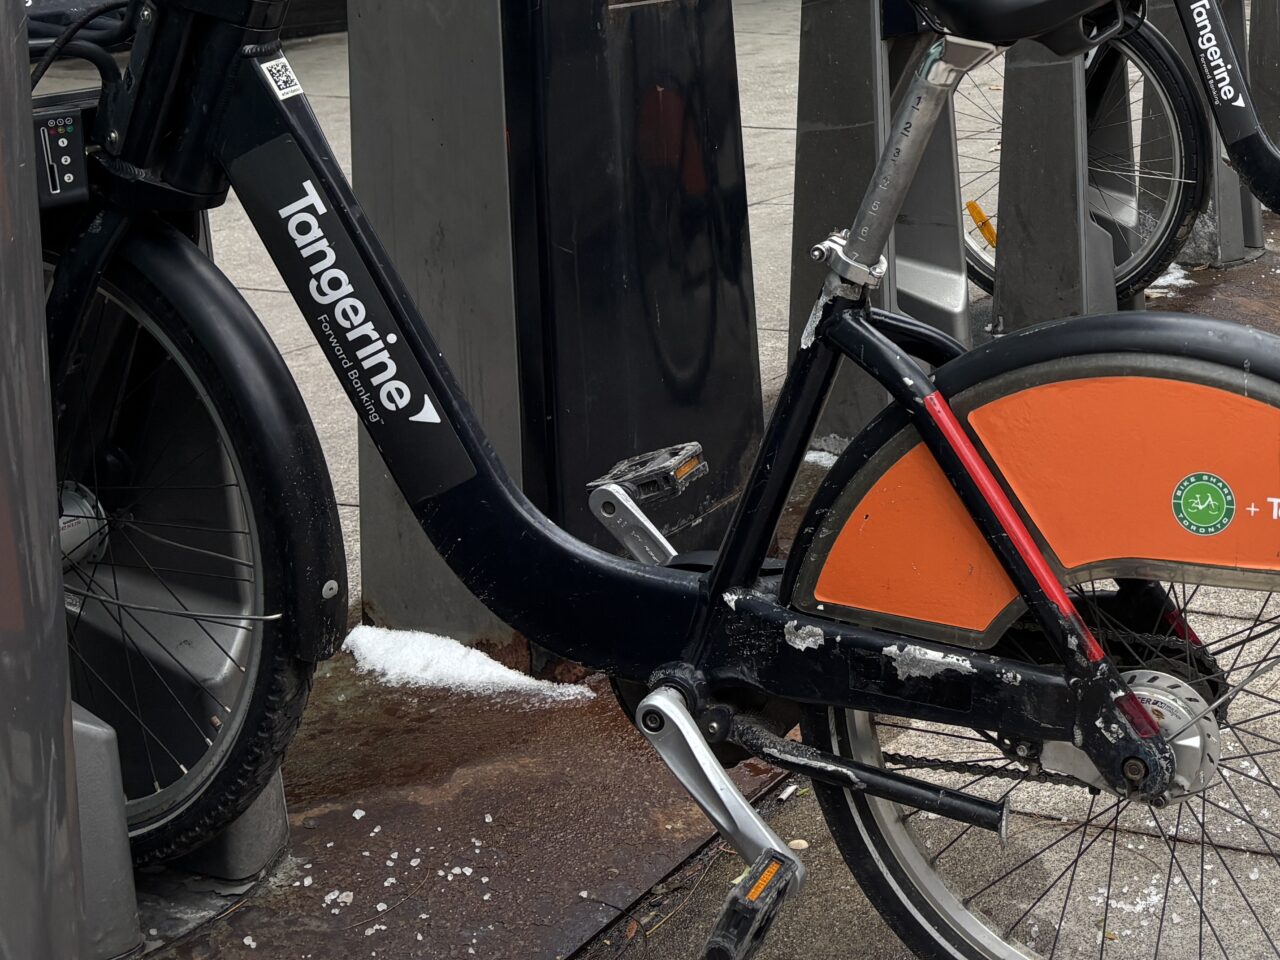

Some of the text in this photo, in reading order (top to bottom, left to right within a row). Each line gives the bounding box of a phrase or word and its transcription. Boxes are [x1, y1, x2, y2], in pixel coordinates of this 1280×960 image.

[278, 179, 412, 412] Tangerine
[316, 313, 350, 370] Forward
[1176, 475, 1232, 501] BIKE SHARE
[1178, 512, 1229, 533] TORONTO
